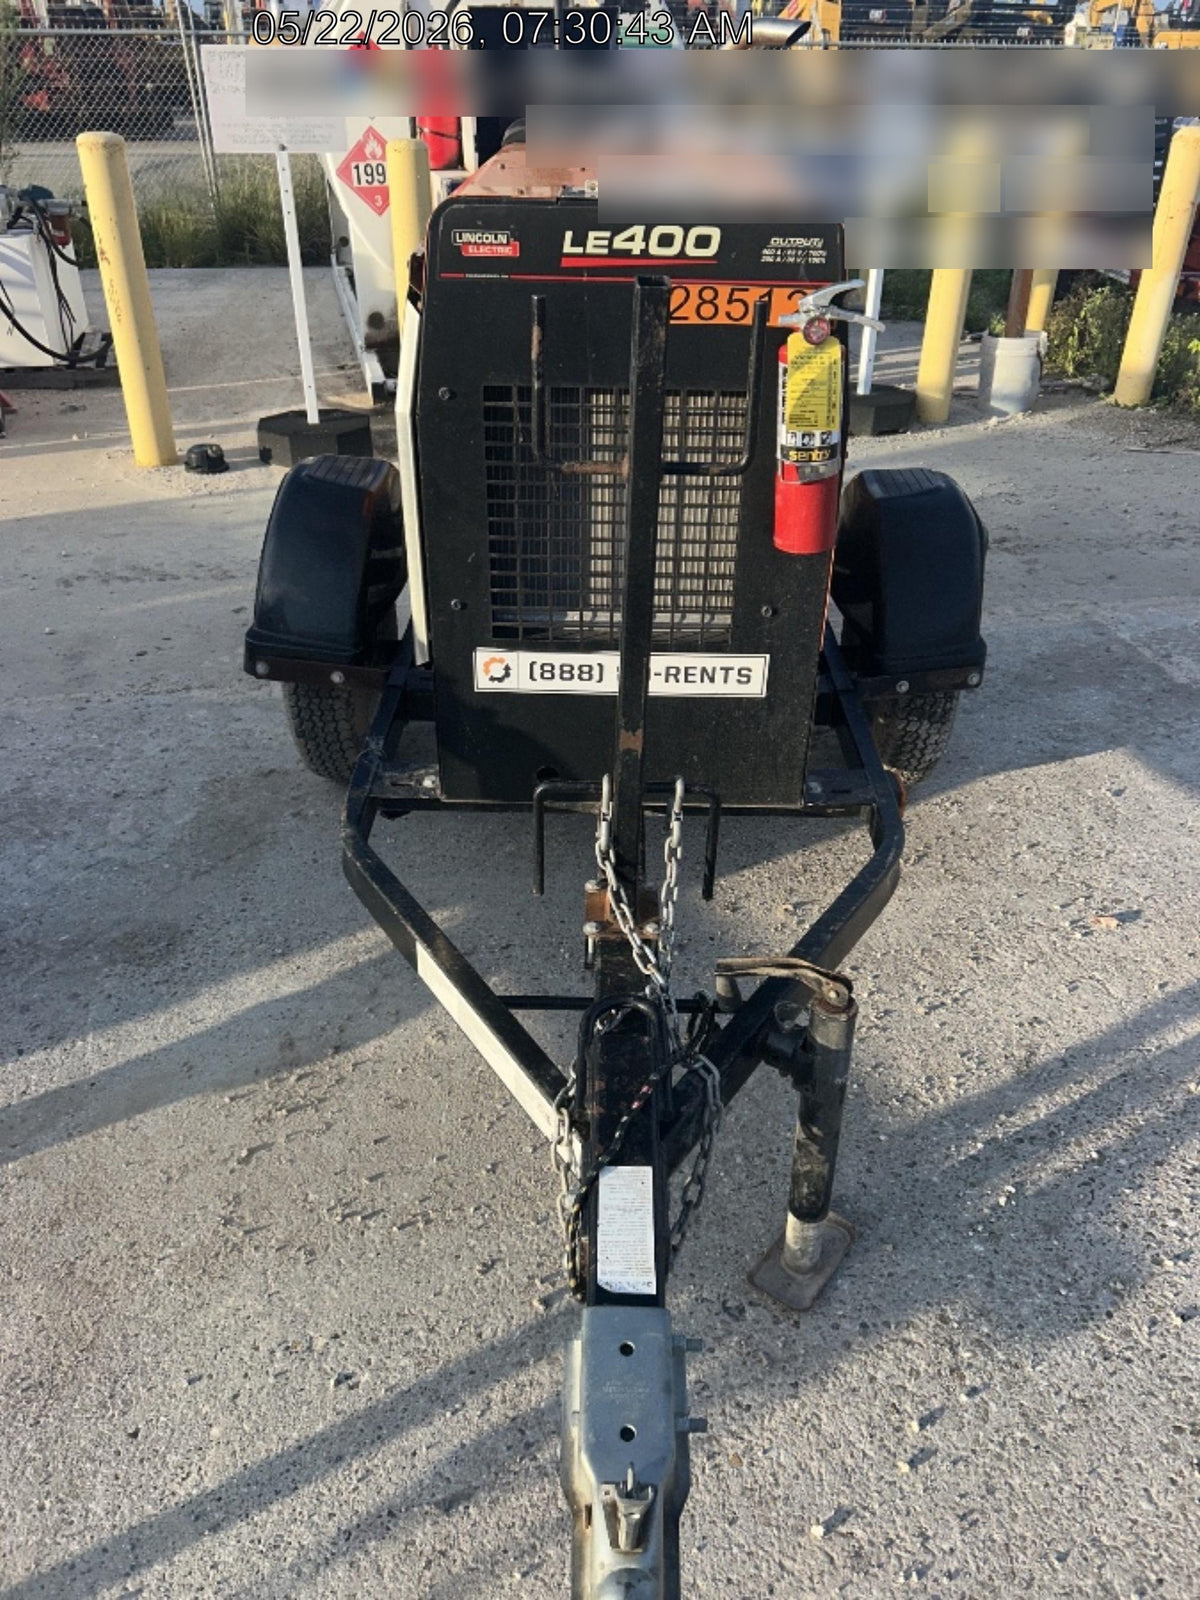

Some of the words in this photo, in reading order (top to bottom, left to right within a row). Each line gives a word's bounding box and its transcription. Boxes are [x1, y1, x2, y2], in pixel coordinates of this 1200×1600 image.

[353, 163, 387, 185] 199
[373, 194, 382, 206] 3
[455, 232, 507, 244] LINCOLN
[562, 224, 721, 257] LE400
[468, 245, 513, 255] ELECTRIC
[788, 449, 831, 461] sentry
[528, 661, 604, 683] (888)
[616, 665, 753, 685] -RENTS
